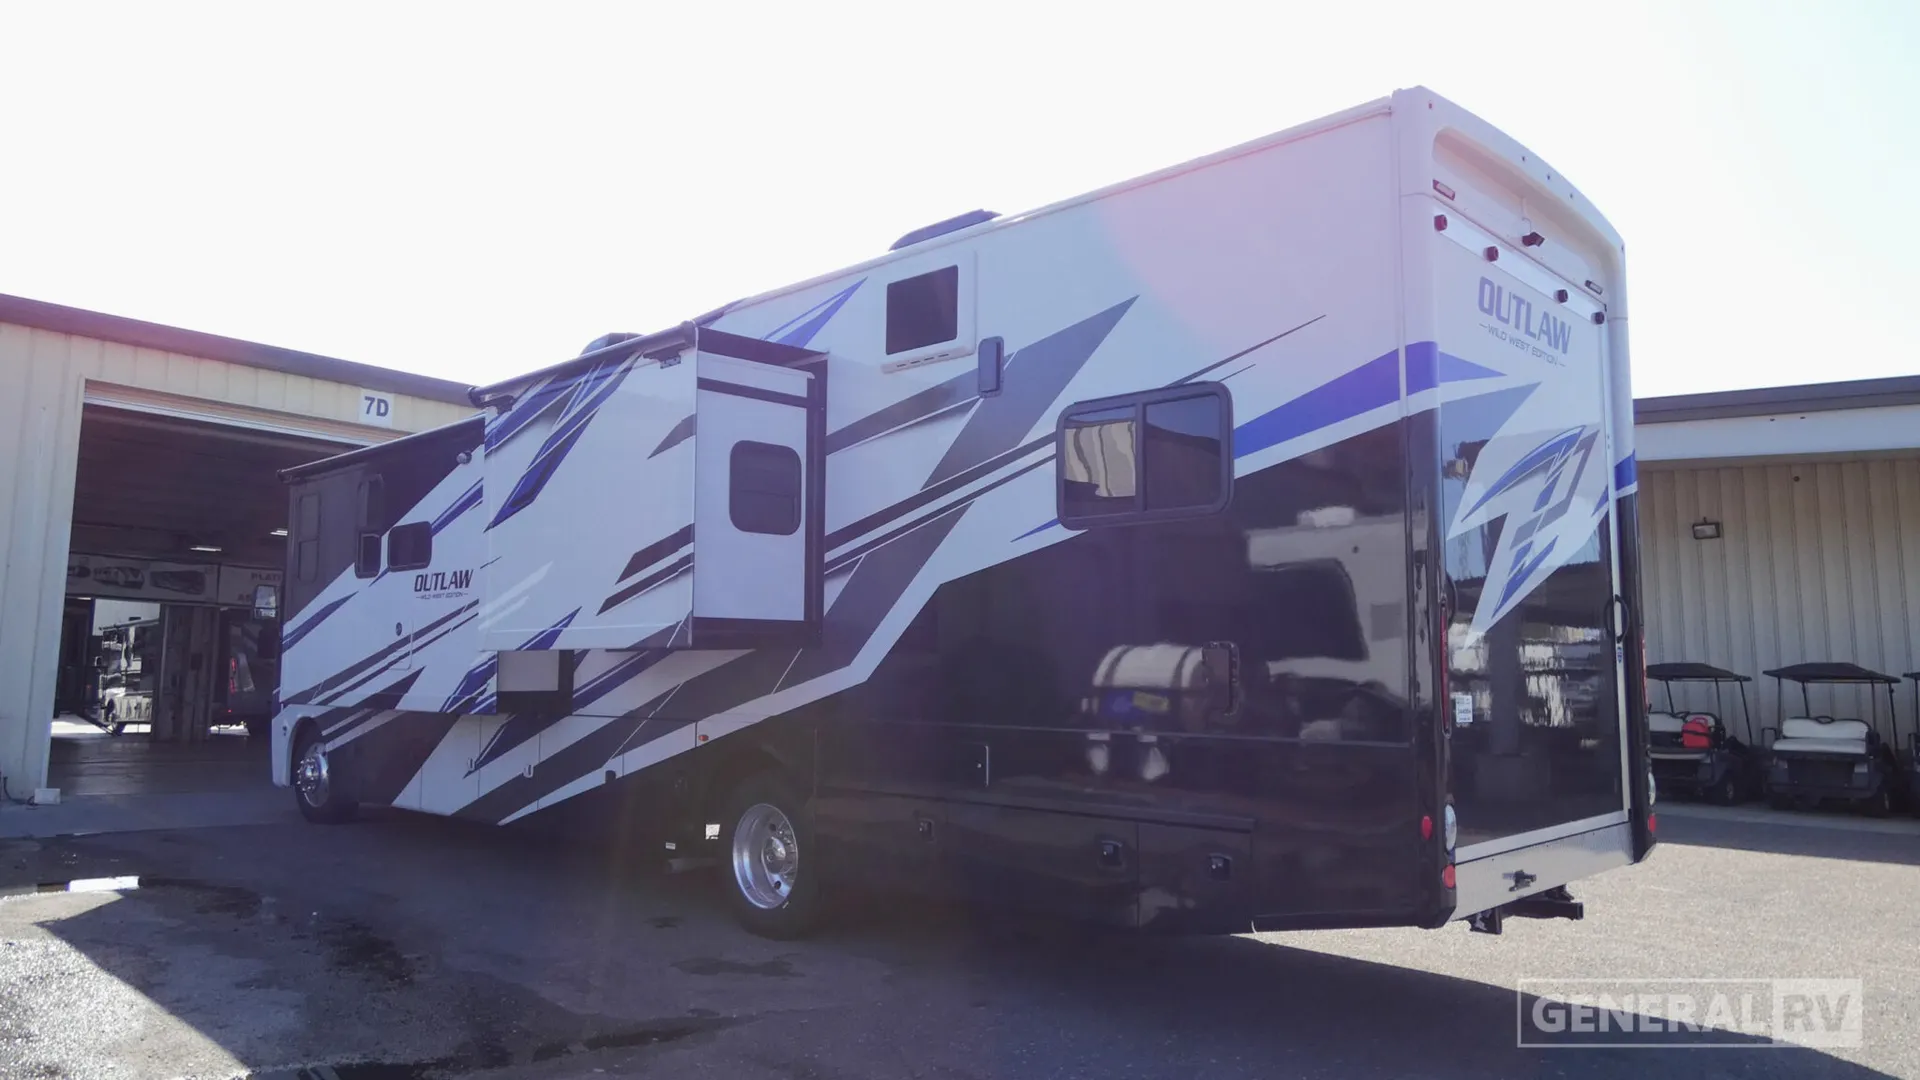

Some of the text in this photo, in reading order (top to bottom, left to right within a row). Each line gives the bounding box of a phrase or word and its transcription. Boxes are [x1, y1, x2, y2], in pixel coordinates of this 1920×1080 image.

[1478, 276, 1571, 354] OUTLAW
[1488, 323, 1559, 366] WILD WEST EDITION
[364, 395, 389, 417] 7D
[414, 569, 474, 592] OUTLAW
